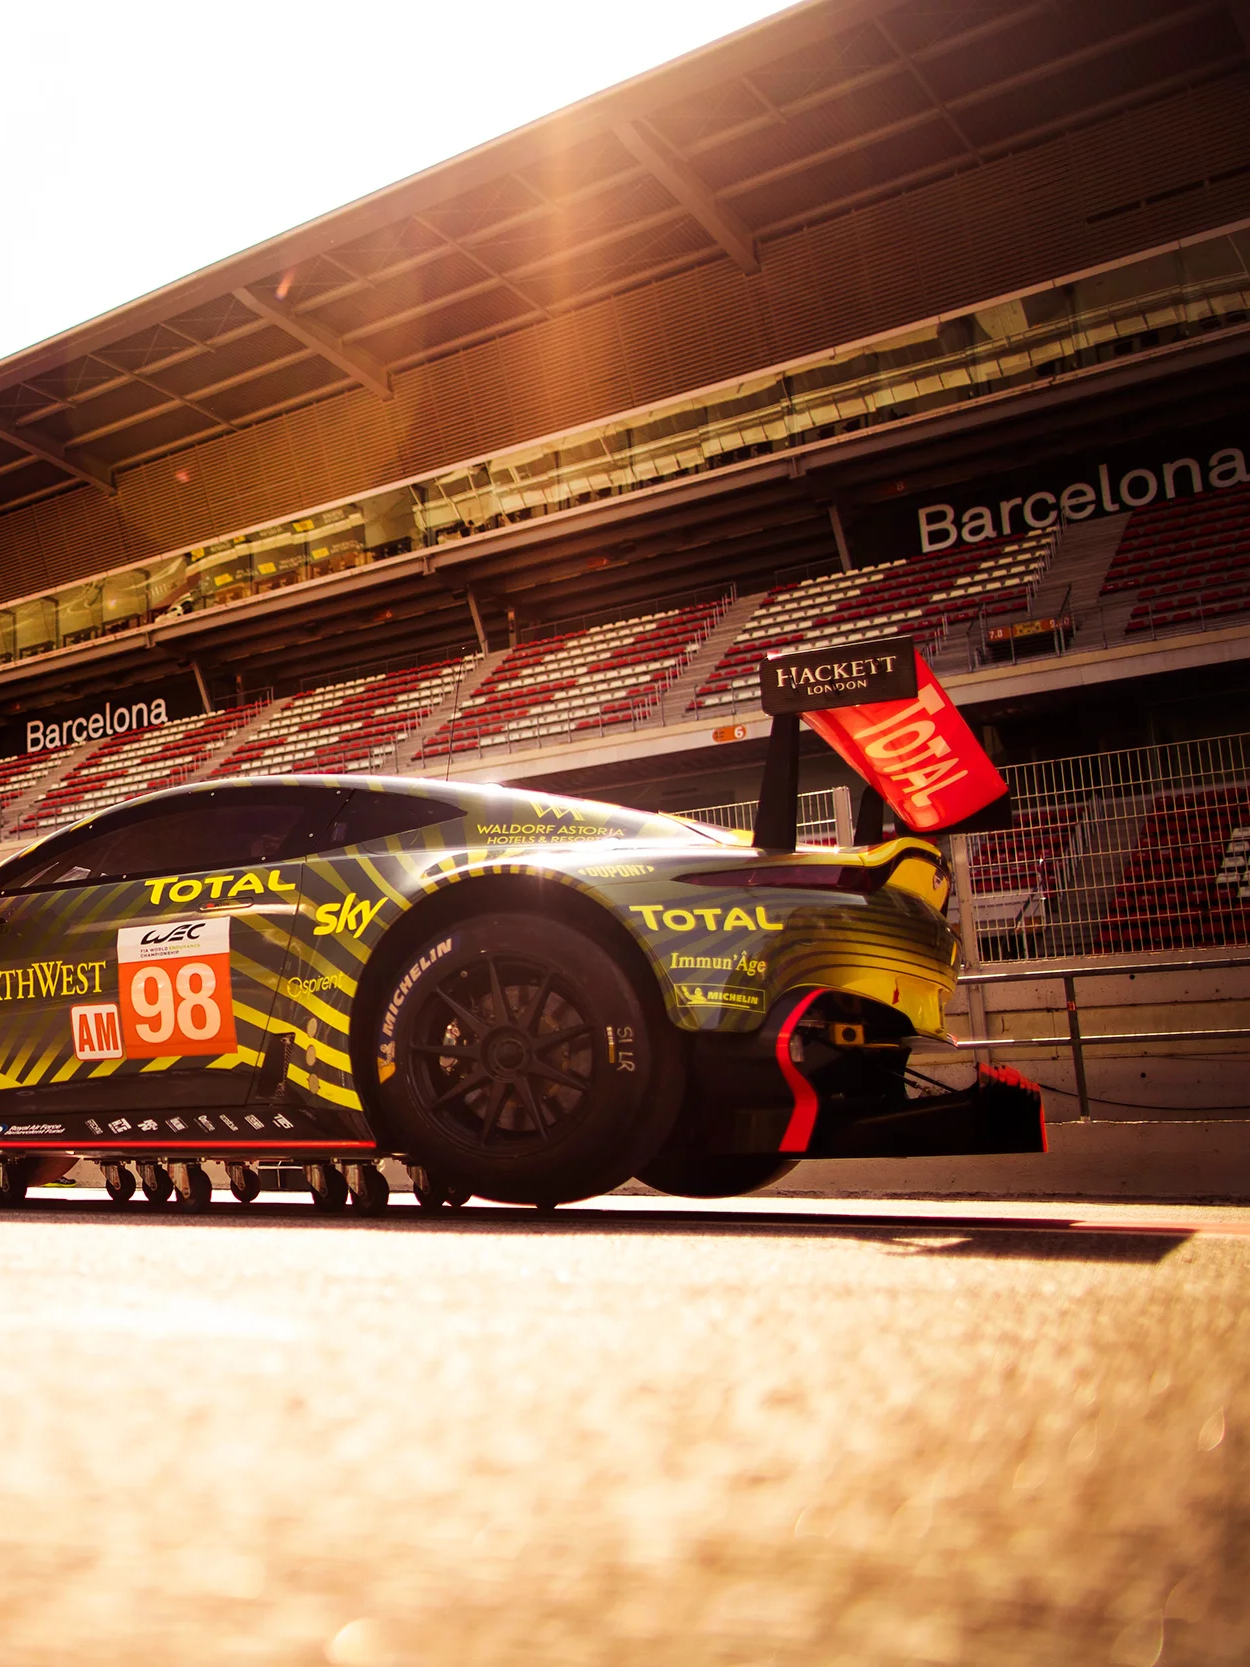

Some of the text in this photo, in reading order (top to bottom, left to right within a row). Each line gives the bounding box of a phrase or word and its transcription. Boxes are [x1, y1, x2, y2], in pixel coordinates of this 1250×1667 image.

[918, 448, 1250, 553] Barcelona
[776, 655, 897, 687] HACKETT
[807, 679, 867, 695] LONDON
[27, 697, 168, 753] Barcelona
[734, 726, 744, 739] 6
[853, 683, 968, 807] TOTAL
[476, 824, 625, 836] WALDORF ASTORIA
[487, 836, 534, 844] HOTELS
[538, 836, 547, 844] &
[586, 864, 646, 878] DUPONT
[144, 869, 296, 905] TOTAL
[313, 893, 388, 938] sky
[629, 904, 784, 932] TOTAL
[140, 923, 206, 945] WEC
[140, 950, 180, 958] CHAMPIONSHIP
[302, 971, 344, 994] spirent
[382, 938, 453, 1037] MICHELIN
[131, 963, 222, 1043] 98
[707, 991, 759, 1005] MICHELIN
[78, 1011, 119, 1053] AM
